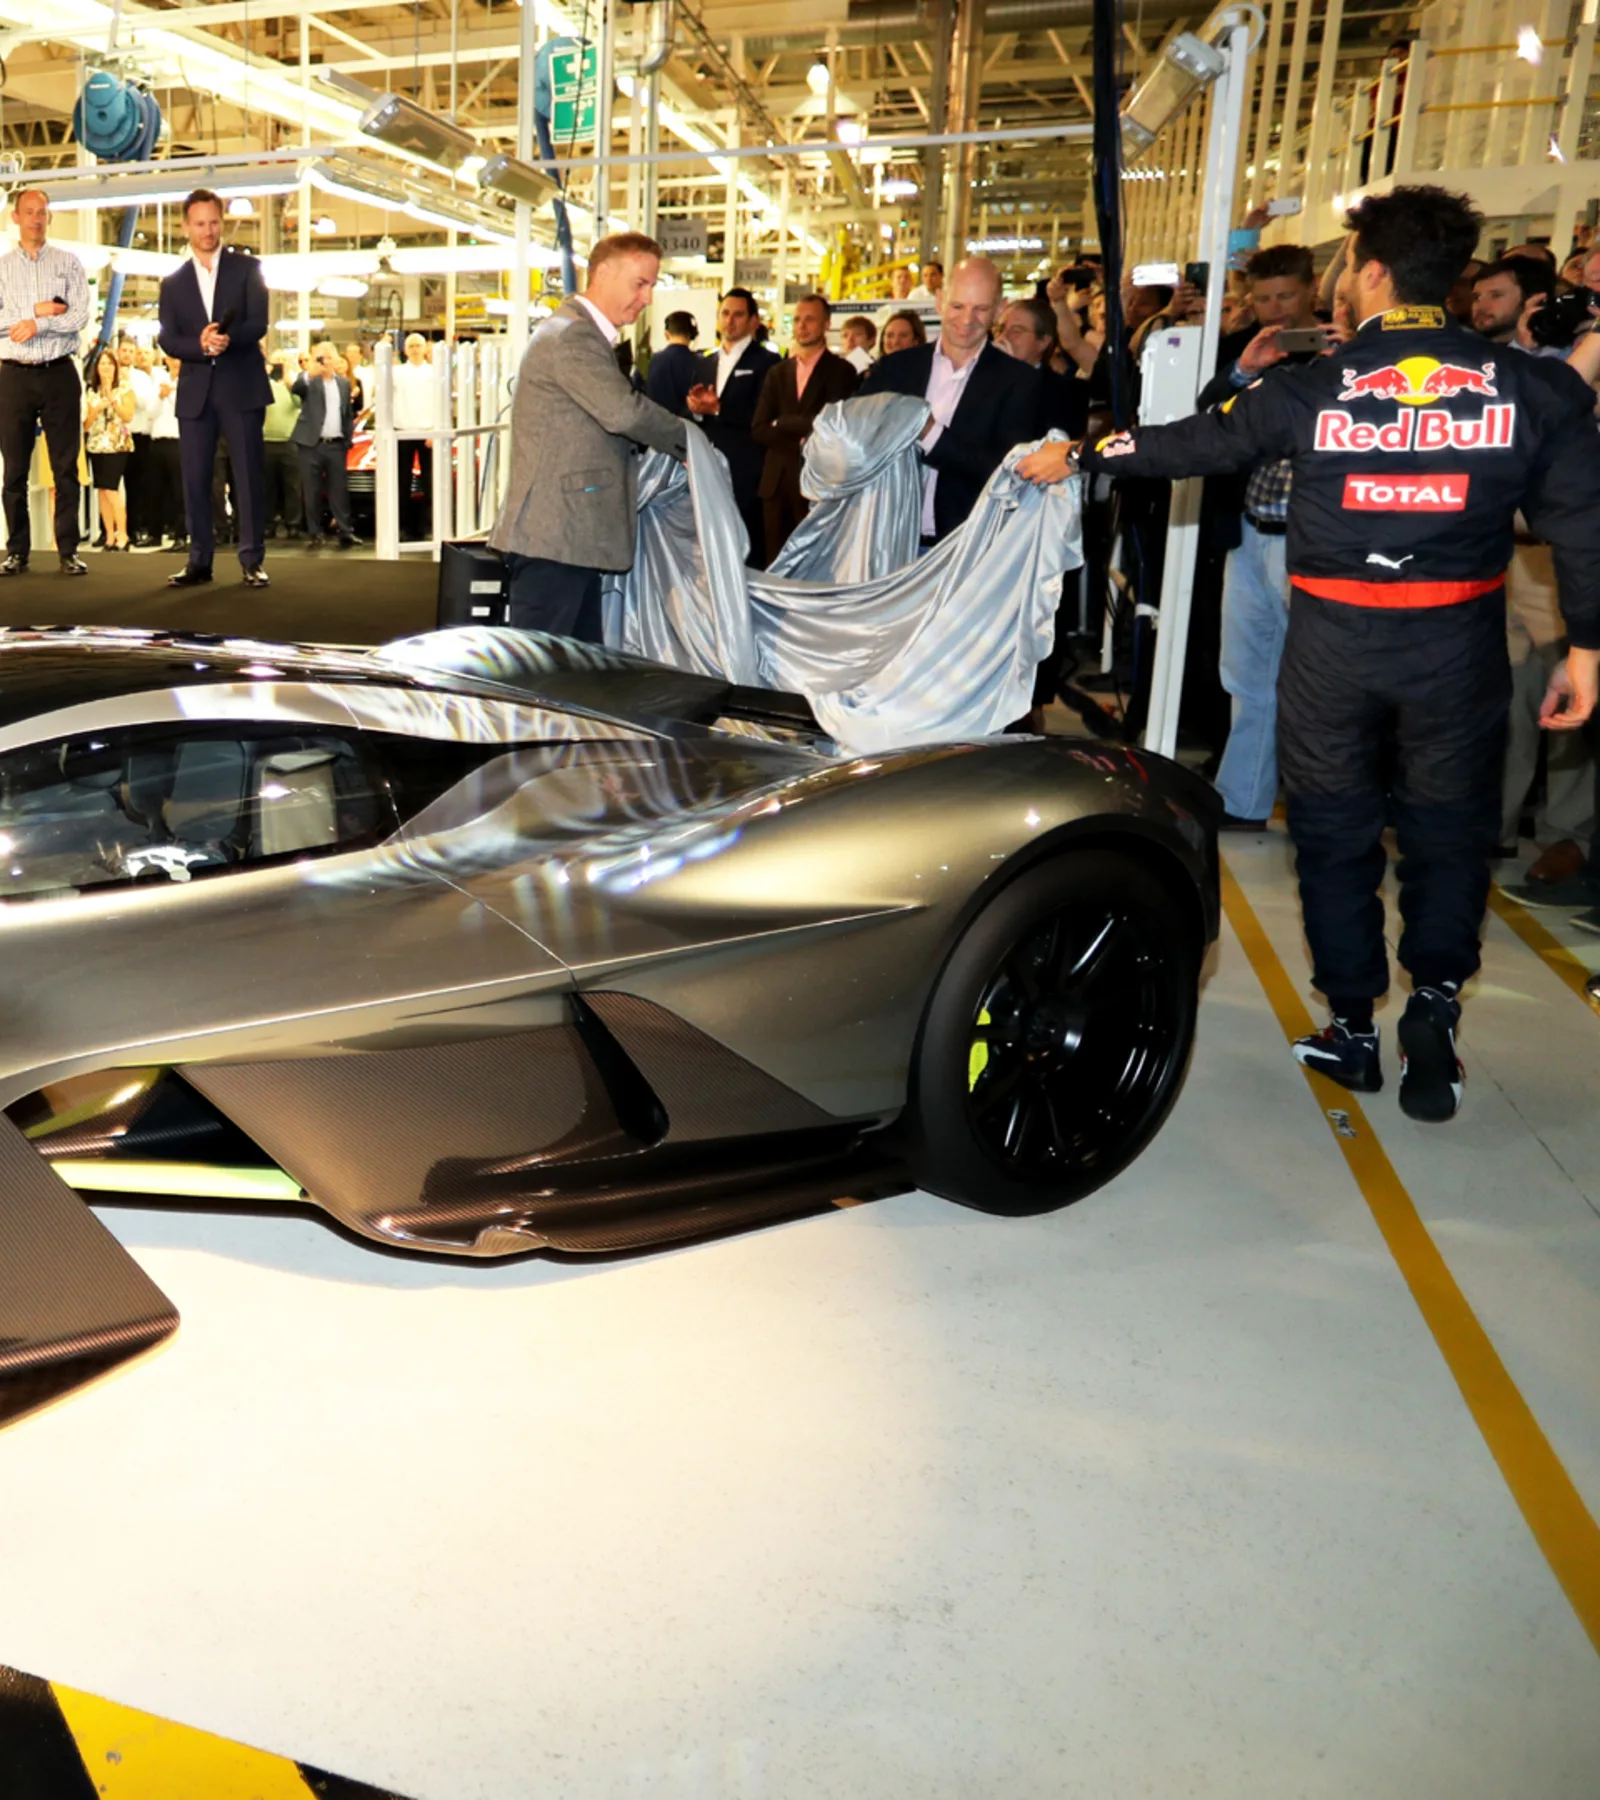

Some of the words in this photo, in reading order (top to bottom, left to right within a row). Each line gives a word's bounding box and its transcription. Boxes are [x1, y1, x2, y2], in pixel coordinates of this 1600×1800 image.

[1314, 408, 1414, 451] Red
[1414, 403, 1515, 451] Bull
[1350, 480, 1463, 504] TOTAL
